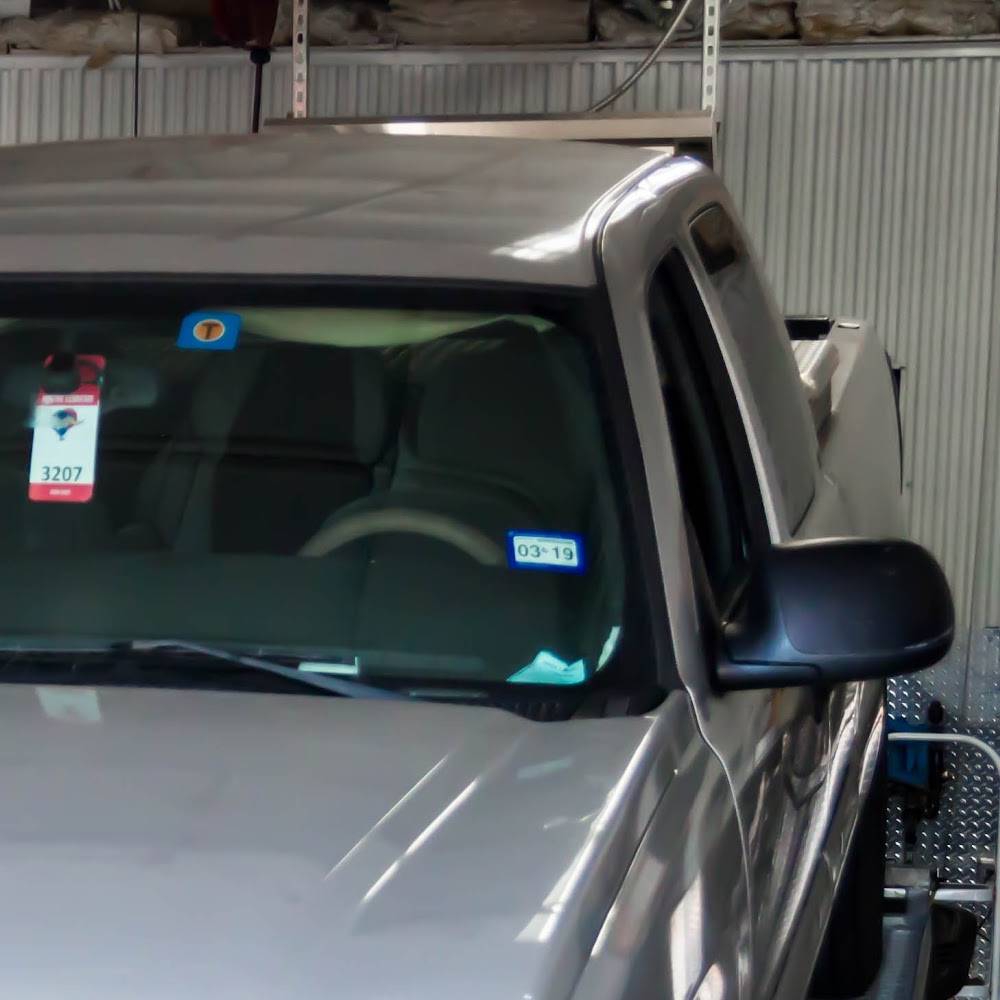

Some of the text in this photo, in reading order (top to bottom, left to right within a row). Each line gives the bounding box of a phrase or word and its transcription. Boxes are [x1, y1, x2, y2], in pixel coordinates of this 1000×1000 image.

[202, 322, 221, 340] T
[41, 466, 83, 482] 3207
[517, 544, 574, 561] 03 19
